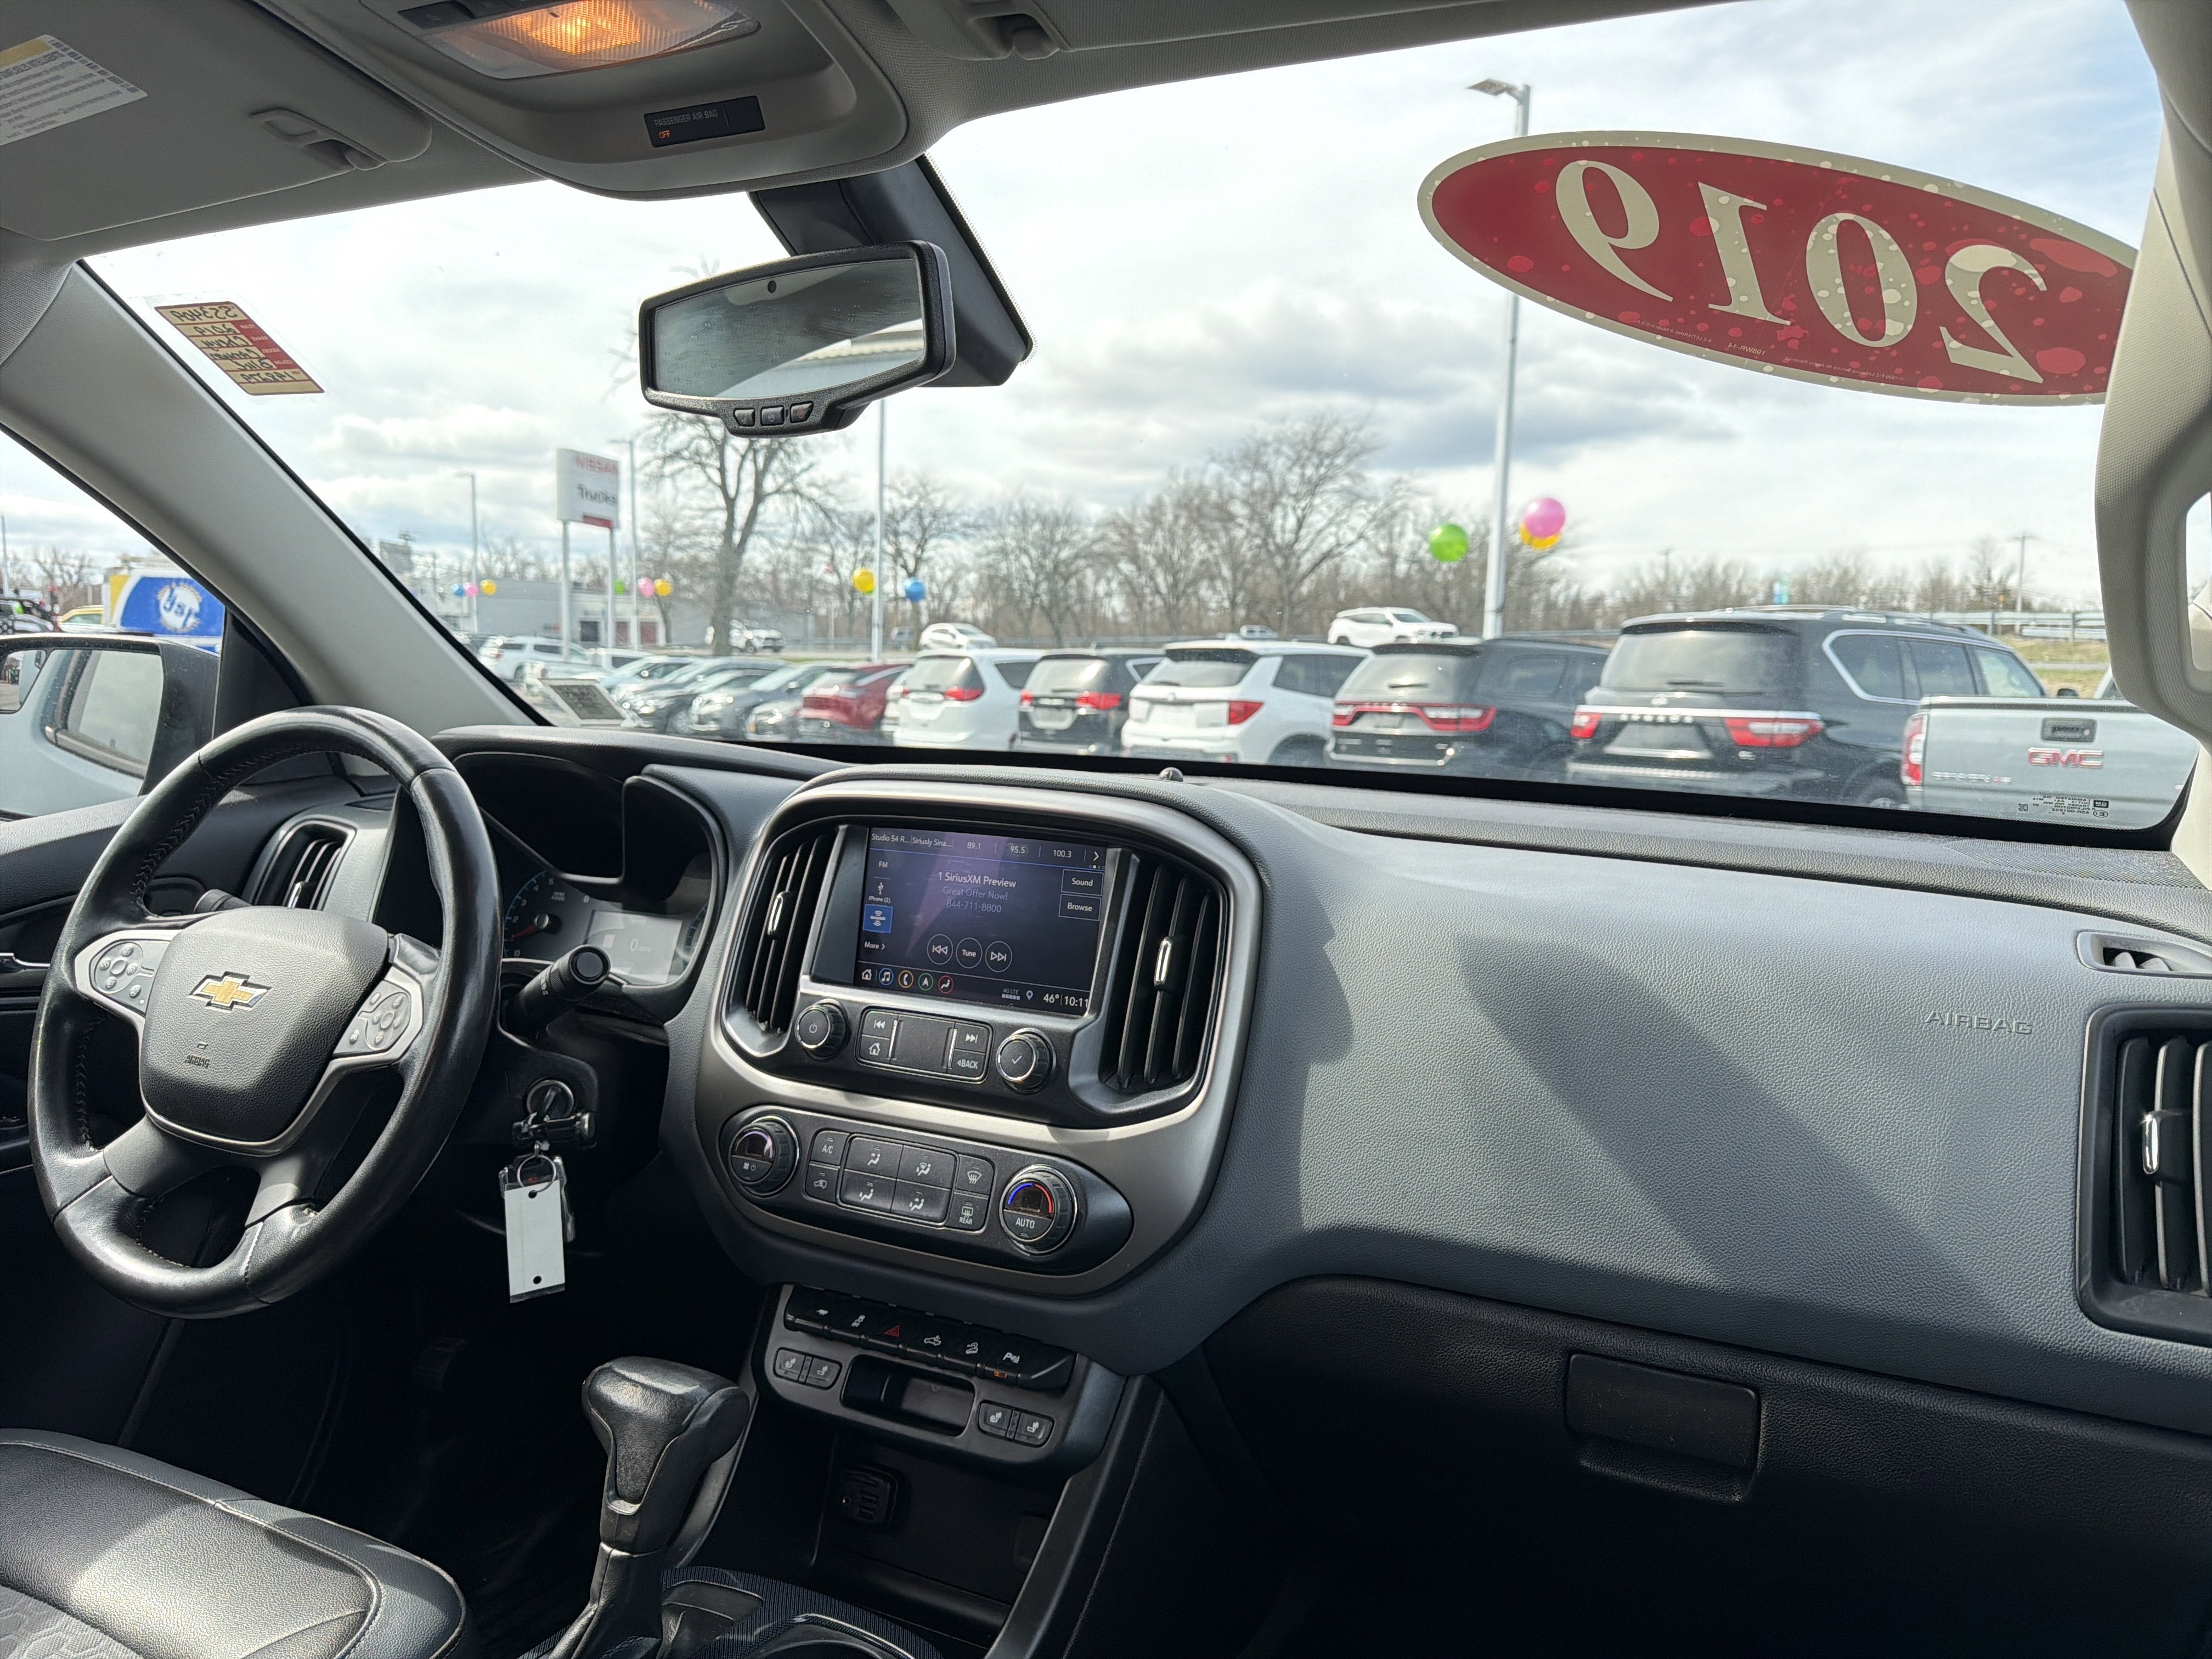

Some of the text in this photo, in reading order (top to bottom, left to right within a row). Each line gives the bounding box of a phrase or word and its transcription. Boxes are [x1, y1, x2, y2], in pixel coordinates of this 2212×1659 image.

[654, 109, 718, 127] PASSENGER AIR BAG
[659, 129, 671, 139] OFF
[2028, 747, 2103, 768] GMC
[871, 833, 890, 842] Studio
[911, 837, 933, 847] Siriusly
[967, 842, 981, 850] 89.1
[1010, 845, 1025, 854] 95.5
[1053, 849, 1072, 858] 100.3
[938, 871, 1017, 888] 1 SiriusXM Preview
[1071, 877, 1093, 887] Sound
[943, 886, 1008, 900] Great Offer Now!
[946, 900, 1002, 913] 844-711-8800
[1067, 901, 1093, 912] Browse
[864, 941, 879, 950] More
[962, 949, 976, 957] Tune
[1064, 996, 1089, 1008] 10:11
[1924, 1010, 2033, 1035] AIRBAG
[960, 1058, 978, 1070] BACK
[822, 1144, 834, 1155] A/C
[959, 1216, 973, 1226] REAR
[1015, 1217, 1035, 1229] AUTO
